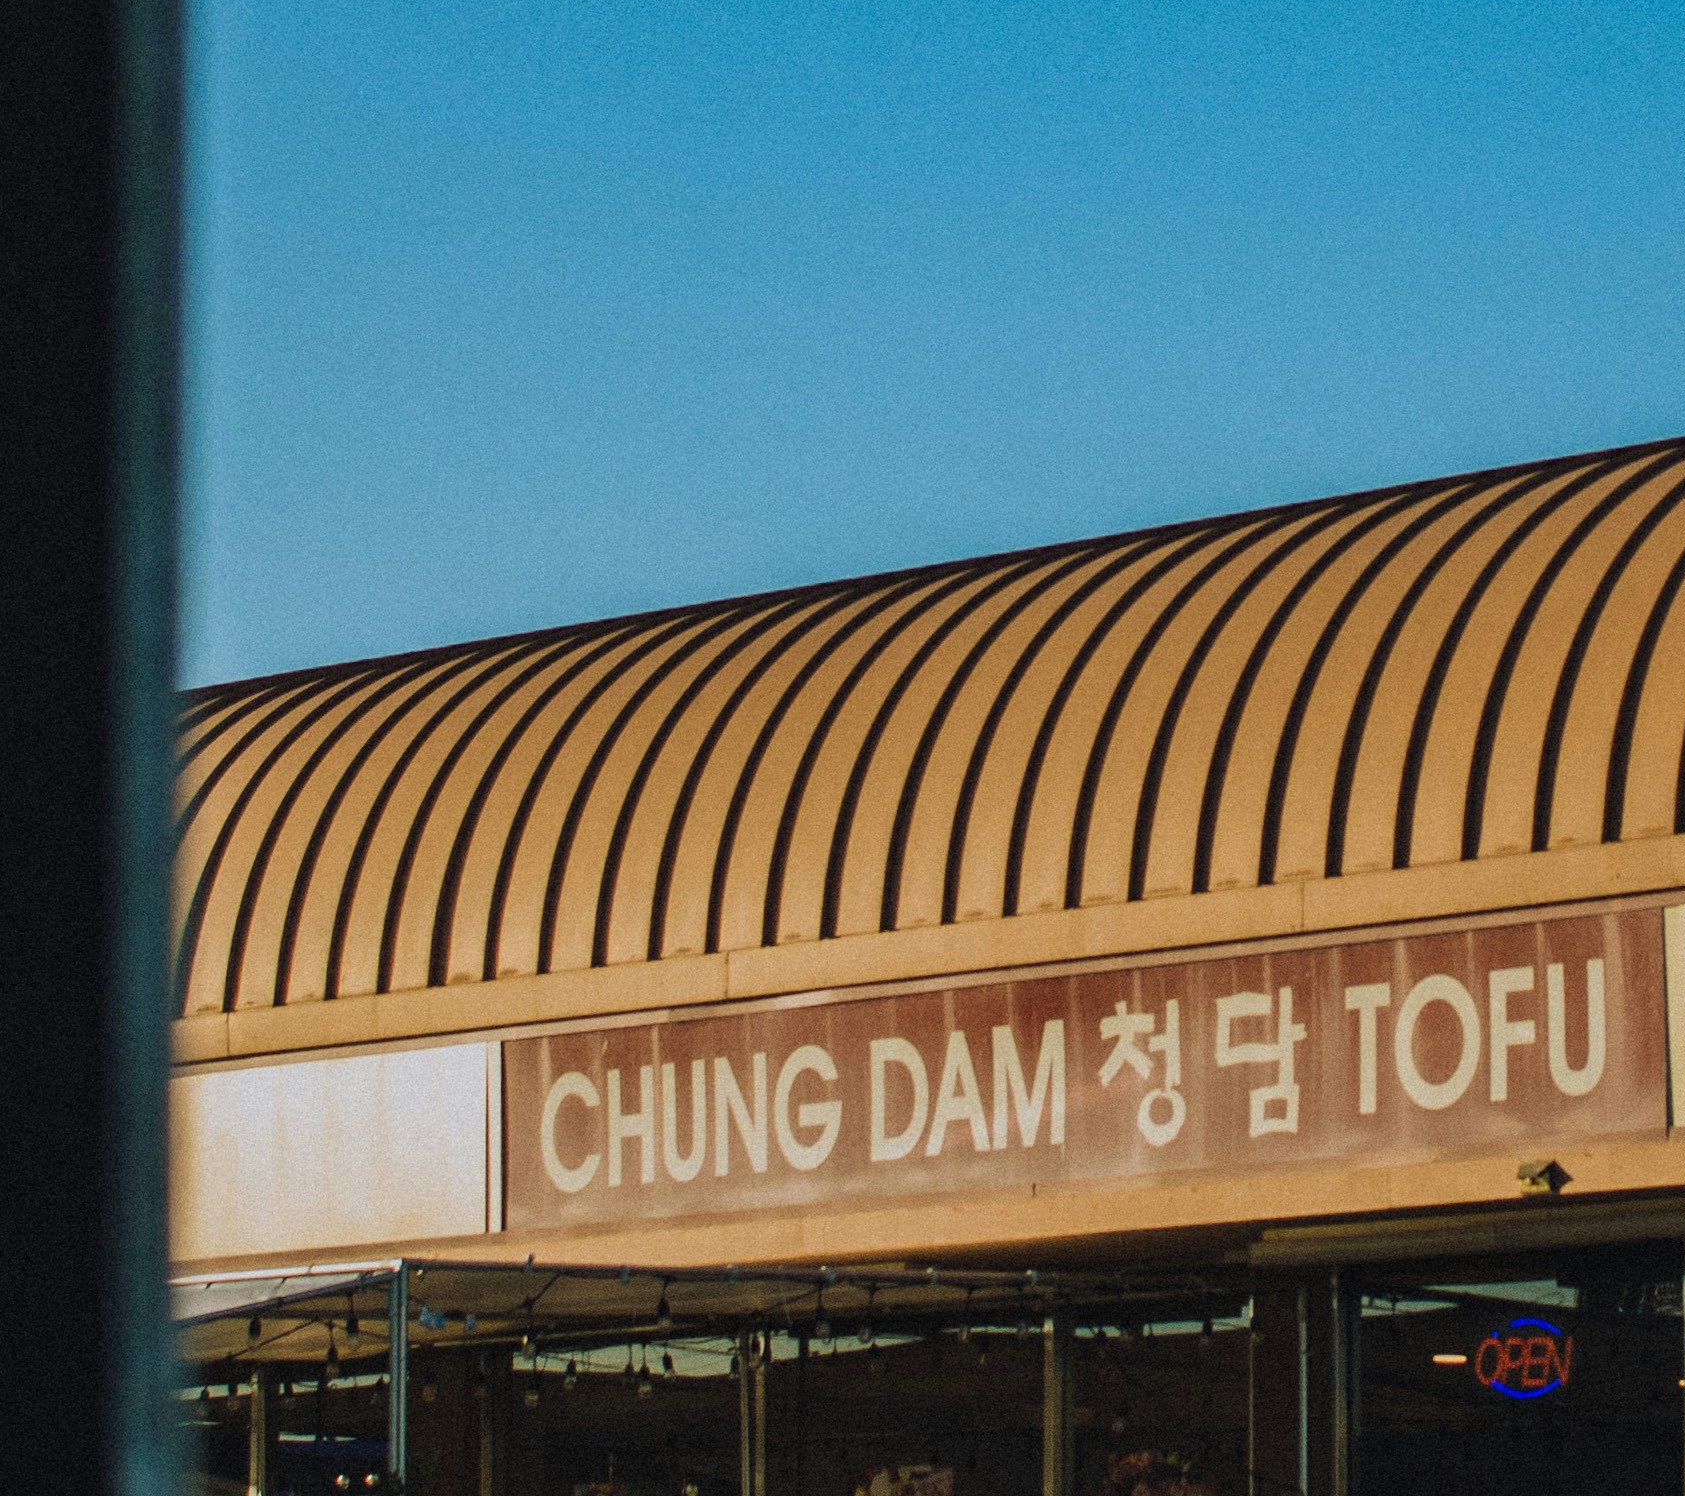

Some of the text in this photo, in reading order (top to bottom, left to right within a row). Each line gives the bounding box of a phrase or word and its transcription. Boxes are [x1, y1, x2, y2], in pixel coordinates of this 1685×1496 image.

[541, 1045, 843, 1193] CHUNG
[869, 1019, 1065, 1162] DAM
[1344, 958, 1606, 1115] TOFU
[1475, 1335, 1574, 1388] OPEN
